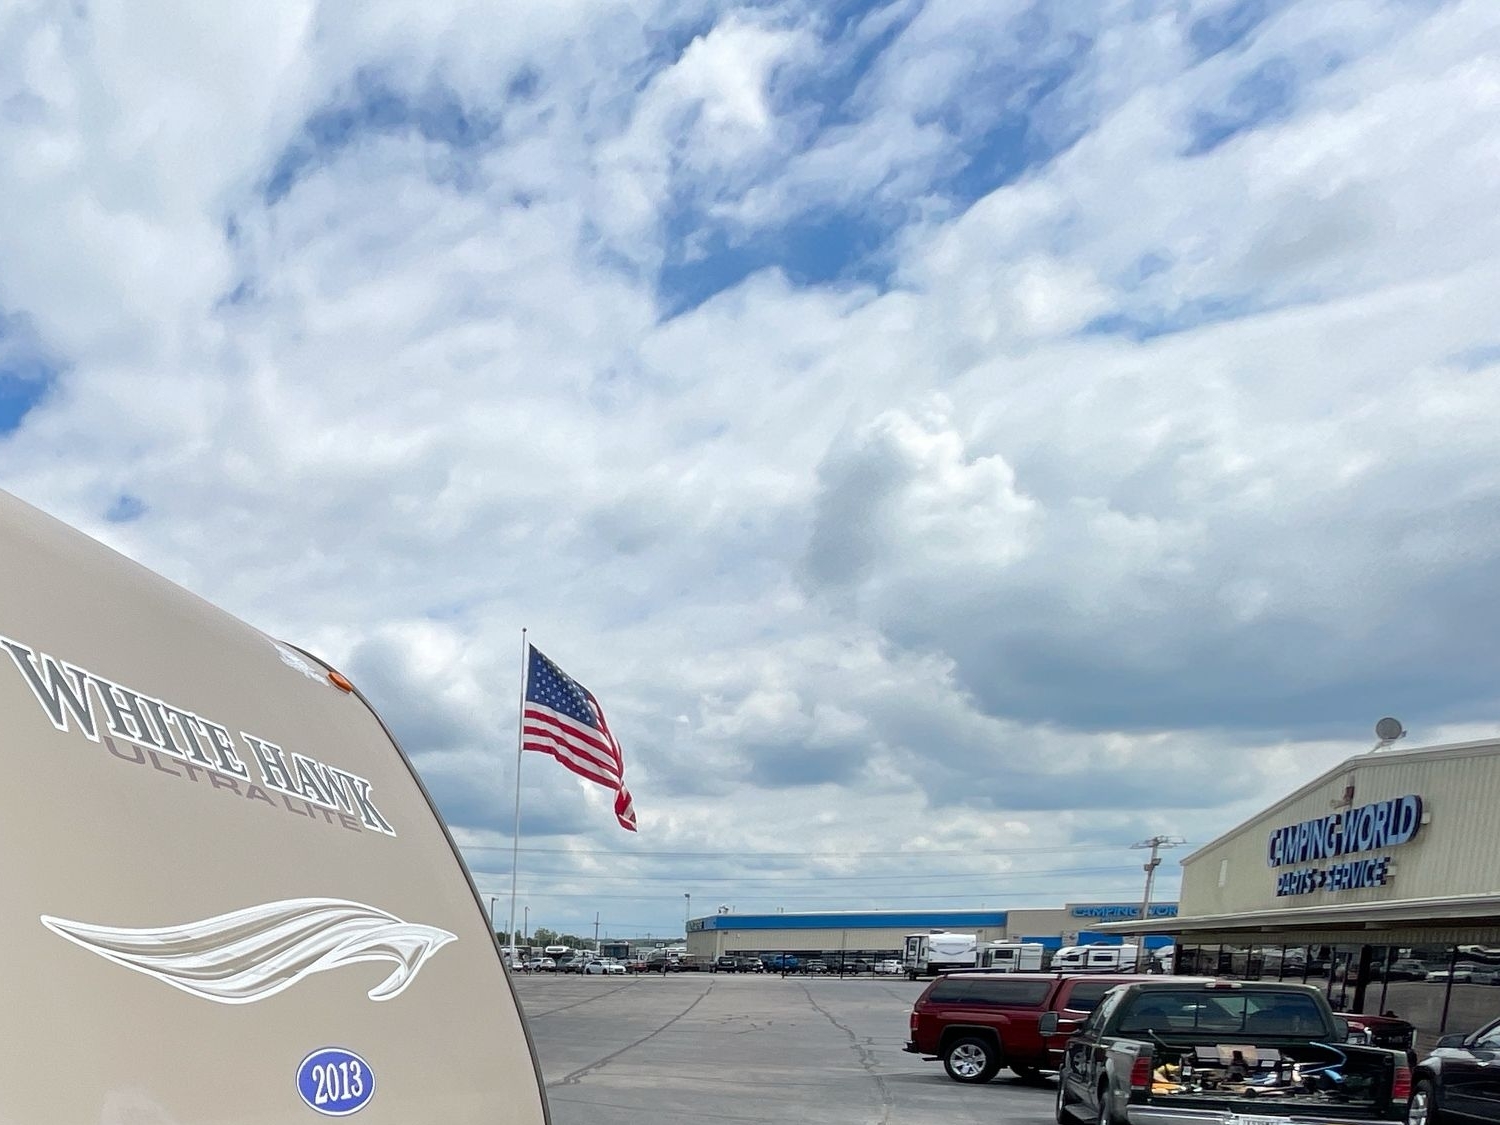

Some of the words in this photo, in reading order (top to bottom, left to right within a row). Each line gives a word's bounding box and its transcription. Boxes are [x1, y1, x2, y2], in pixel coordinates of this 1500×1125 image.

[103, 736, 277, 807] ULTRA
[282, 795, 362, 833] LITE
[241, 731, 397, 838] HAWK
[1267, 814, 1340, 868] CAMPING
[1340, 794, 1423, 854] WORLD
[1276, 868, 1317, 897] PARTS
[1324, 857, 1390, 892] SERVICE
[1072, 905, 1139, 917] CAMPING
[312, 1060, 363, 1105] 2013
